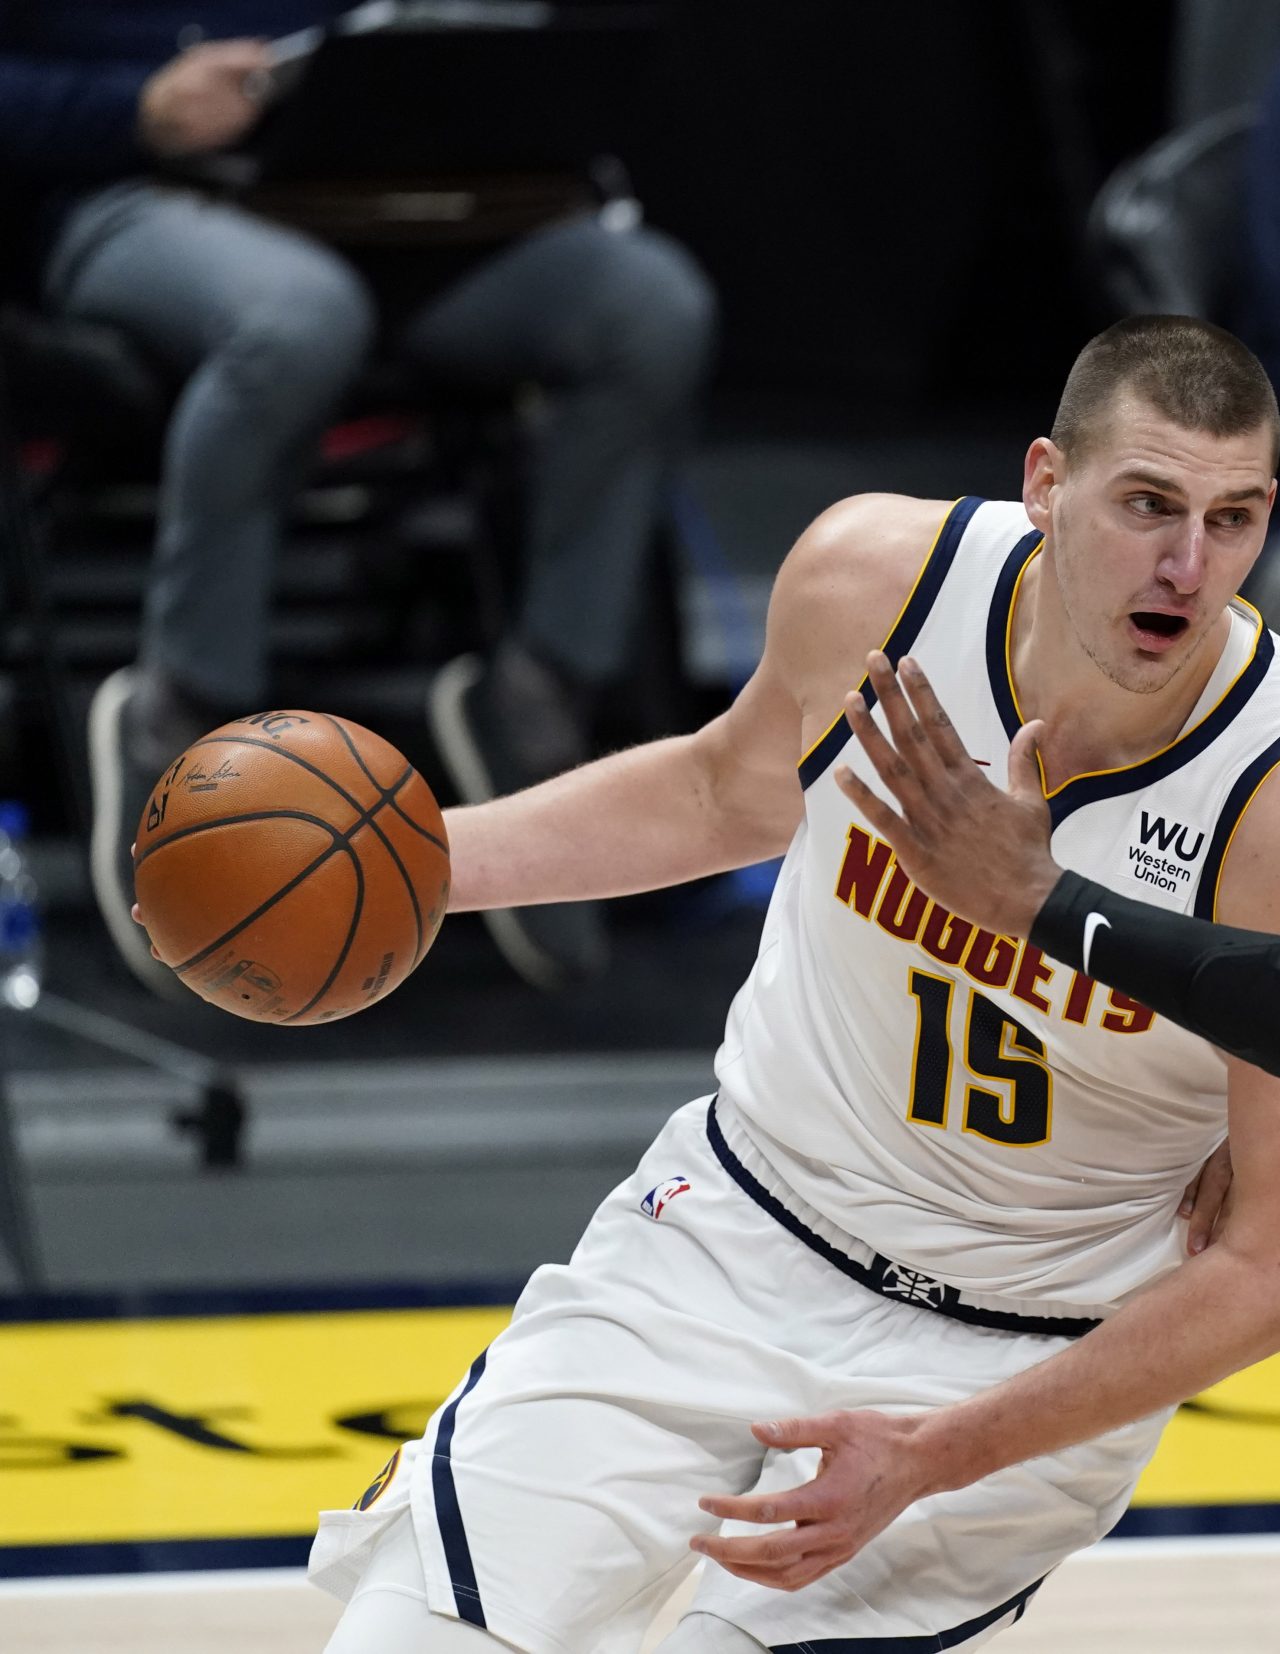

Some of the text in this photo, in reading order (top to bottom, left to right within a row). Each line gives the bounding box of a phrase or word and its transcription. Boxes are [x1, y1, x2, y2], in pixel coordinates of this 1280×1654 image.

[1140, 811, 1205, 861] WU
[1129, 846, 1191, 882] Western
[1134, 864, 1177, 893] Union
[906, 966, 1053, 1148] 15
